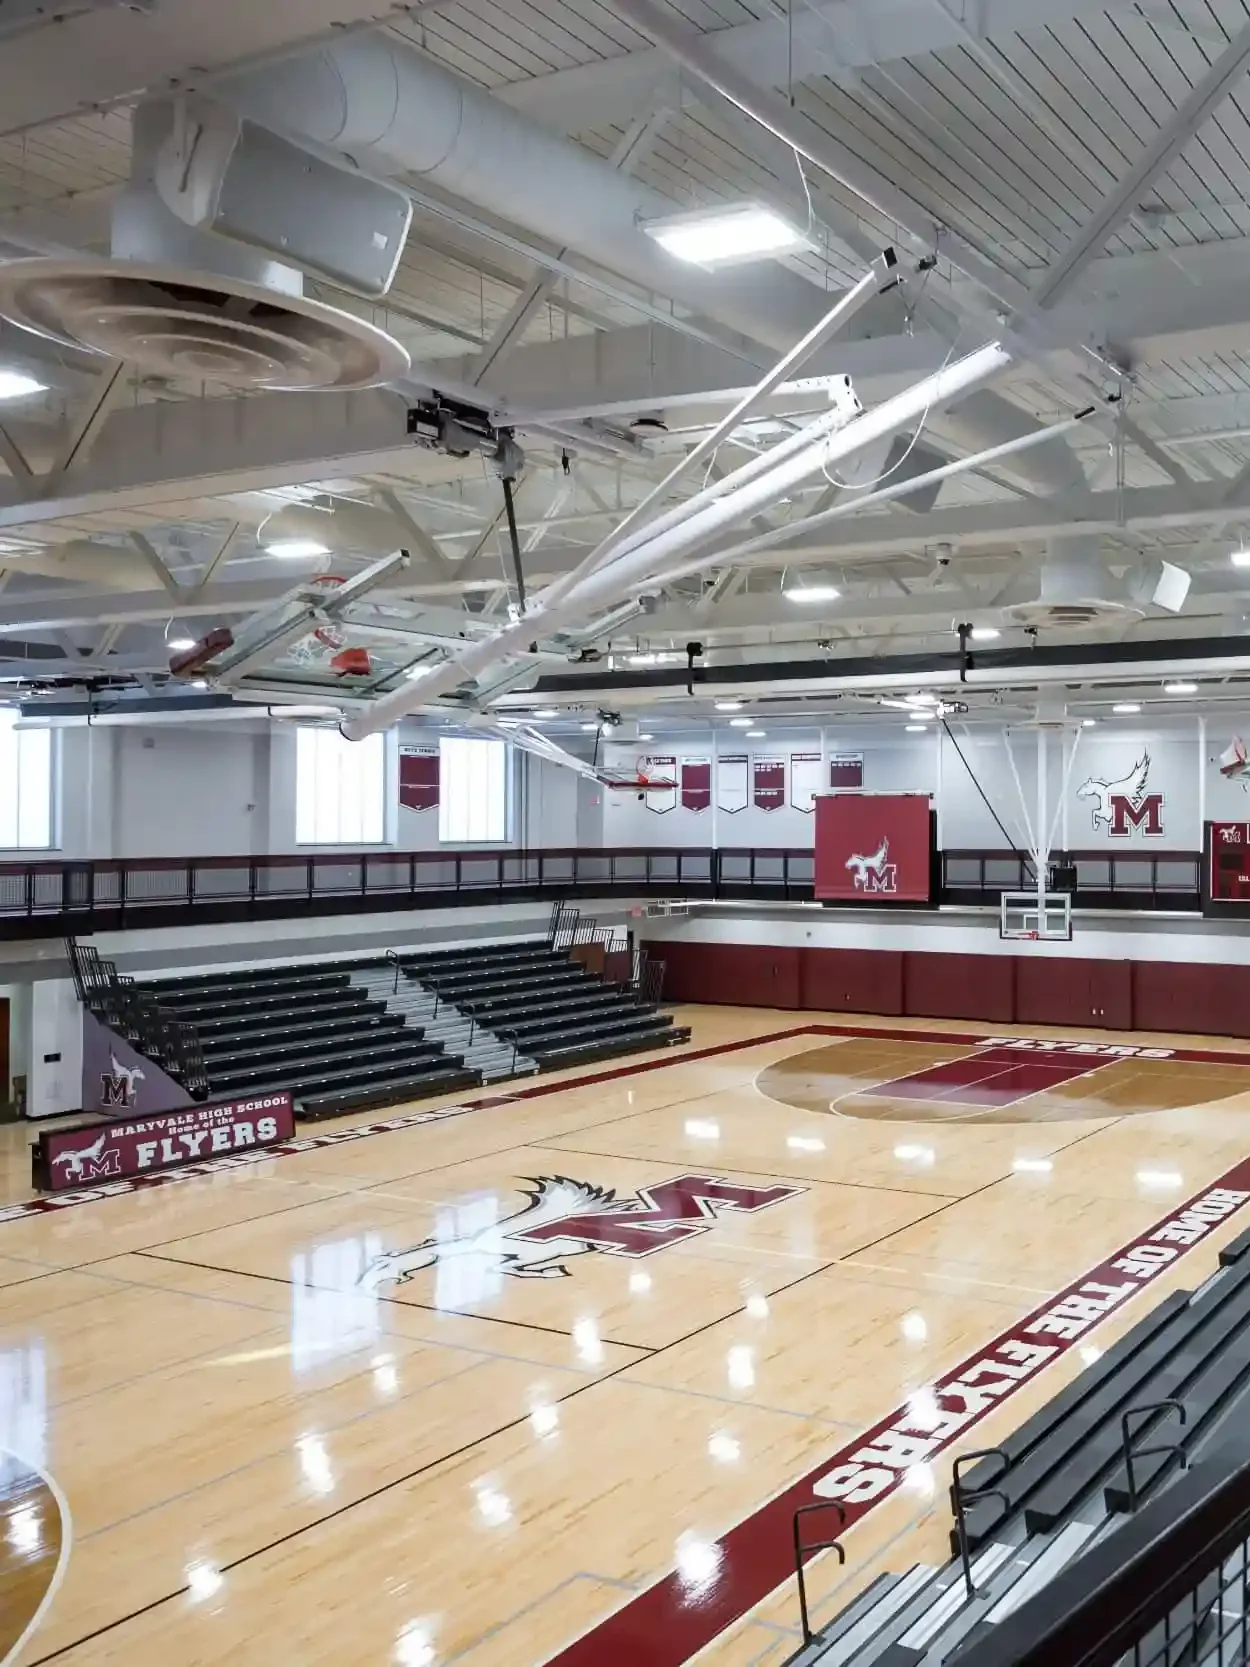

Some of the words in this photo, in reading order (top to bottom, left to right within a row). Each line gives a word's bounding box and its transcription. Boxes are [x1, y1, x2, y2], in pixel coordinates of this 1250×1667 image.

[1108, 792, 1165, 837] M
[863, 864, 897, 892] M
[974, 1037, 1176, 1058] FLYERS
[110, 1112, 194, 1138] MARYVALE
[199, 1106, 233, 1121] HIGH
[237, 1096, 288, 1113] SCHOOL
[168, 1123, 200, 1135] Home
[203, 1118, 214, 1129] of
[216, 1115, 235, 1126] the
[136, 1116, 278, 1168] FLYERS
[1112, 1245, 1180, 1278] OF
[1024, 1281, 1139, 1338] THE
[812, 1338, 1060, 1503] FLYERS
